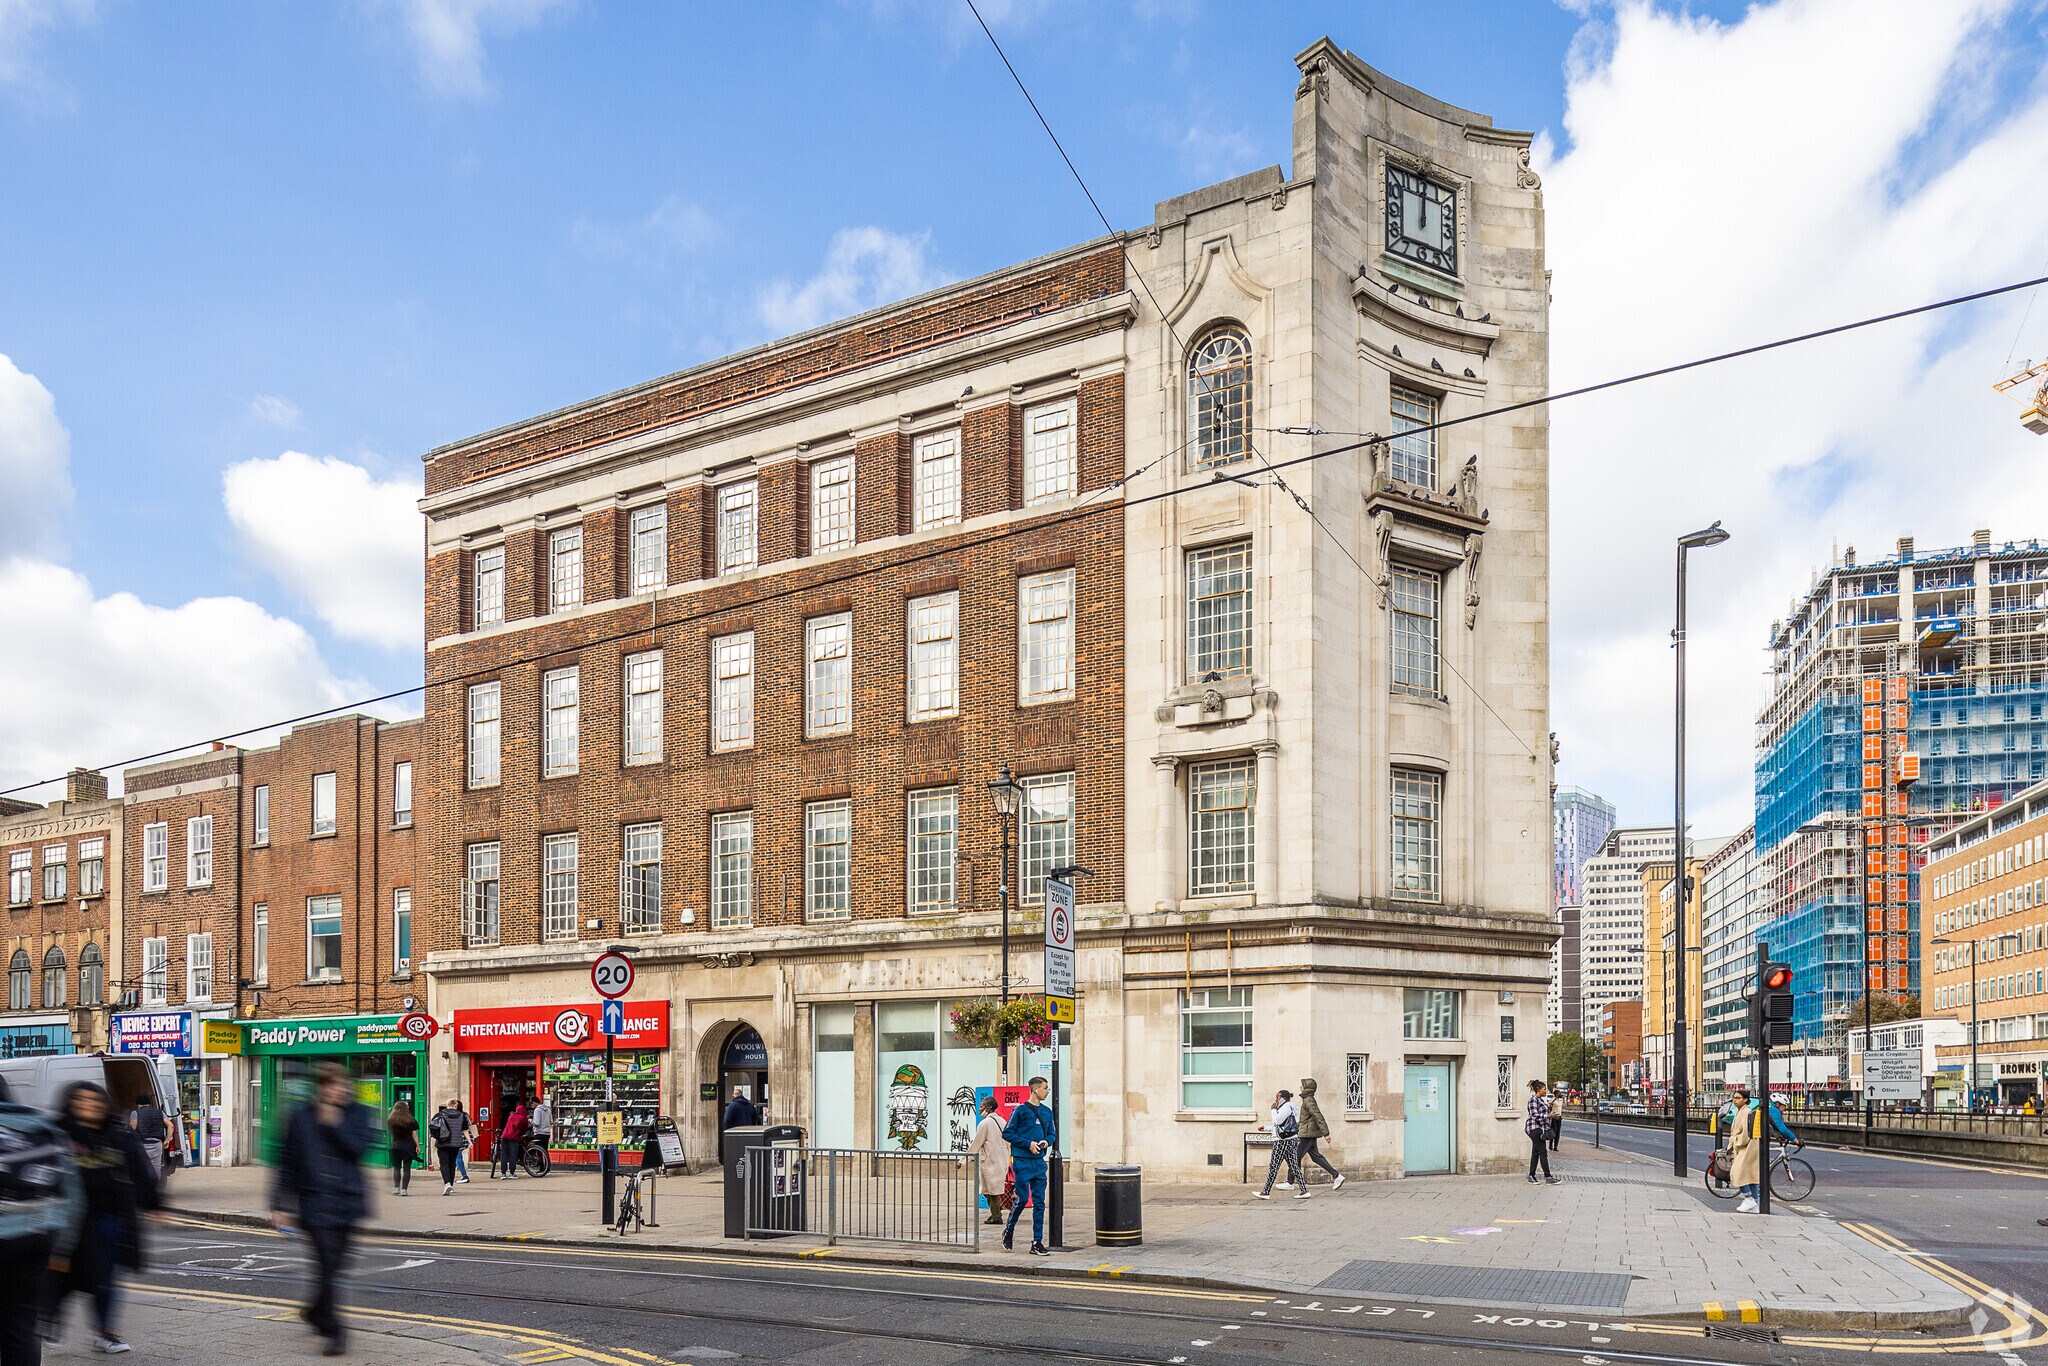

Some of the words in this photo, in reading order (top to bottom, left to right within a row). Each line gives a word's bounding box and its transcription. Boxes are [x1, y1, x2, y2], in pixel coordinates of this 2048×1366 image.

[1388, 202, 1401, 217] 9
[1388, 221, 1401, 238] 8
[1402, 241, 1411, 254] 7
[1416, 246, 1427, 261] 6
[1432, 251, 1442, 266] 5
[1048, 884, 1072, 897] PEDESTRIAN
[1051, 892, 1069, 906] ZONE
[1051, 951, 1063, 960] Except
[1054, 959, 1067, 969] loading
[598, 965, 627, 985] 20
[121, 1016, 150, 1032] DEVICE
[150, 1015, 181, 1032] EXPERT
[357, 1023, 398, 1033] paddypowe
[459, 1021, 550, 1037] ENTERTAINMENT
[597, 1017, 659, 1033] EANGE
[209, 1031, 238, 1039] Paddy
[250, 1027, 297, 1046] Paddy
[298, 1025, 348, 1043] Power
[641, 1055, 659, 1066] CASH
[2000, 1063, 2037, 1075] BROWNS
[1290, 1301, 1436, 1319] LEFT
[1472, 1314, 1600, 1332] LOOK
